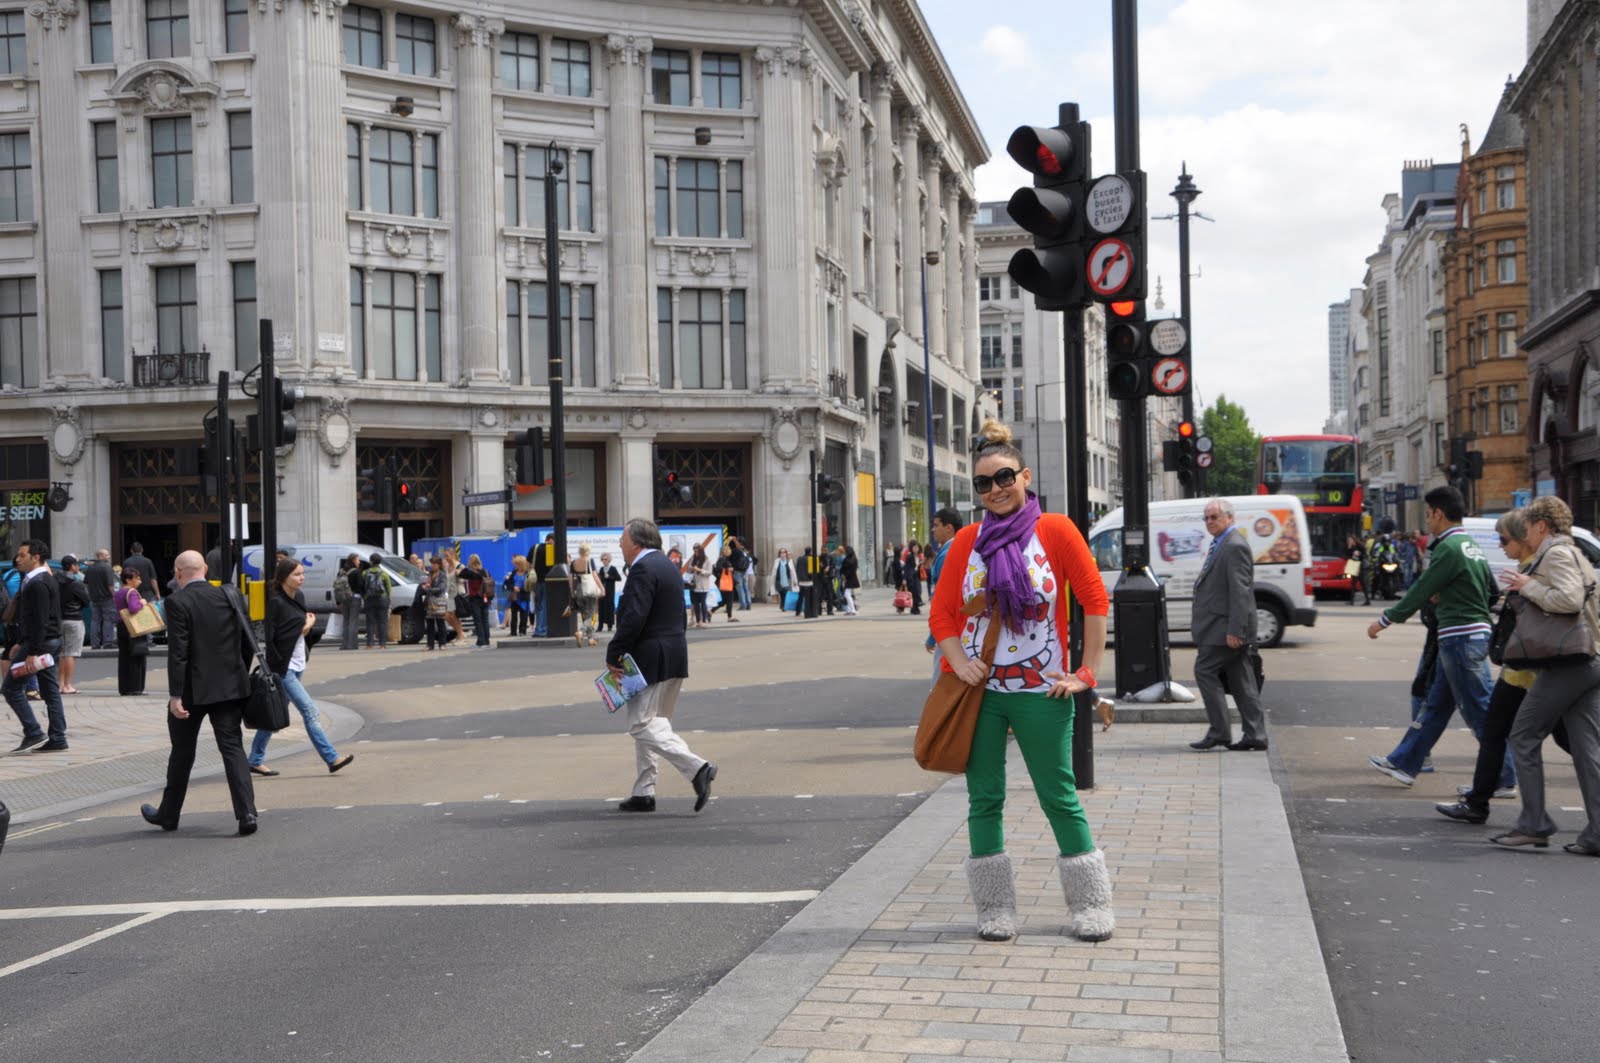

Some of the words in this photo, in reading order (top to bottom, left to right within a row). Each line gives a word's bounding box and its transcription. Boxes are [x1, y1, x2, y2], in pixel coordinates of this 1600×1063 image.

[1093, 185, 1124, 199] Except
[1094, 205, 1123, 217] cycles
[1094, 217, 1100, 226] &
[1103, 212, 1125, 224] taxis
[513, 413, 610, 422] NIKTOWN
[10, 492, 24, 505] BE
[24, 492, 47, 505] FAST
[1329, 490, 1342, 502] 10
[10, 505, 46, 520] SEEN
